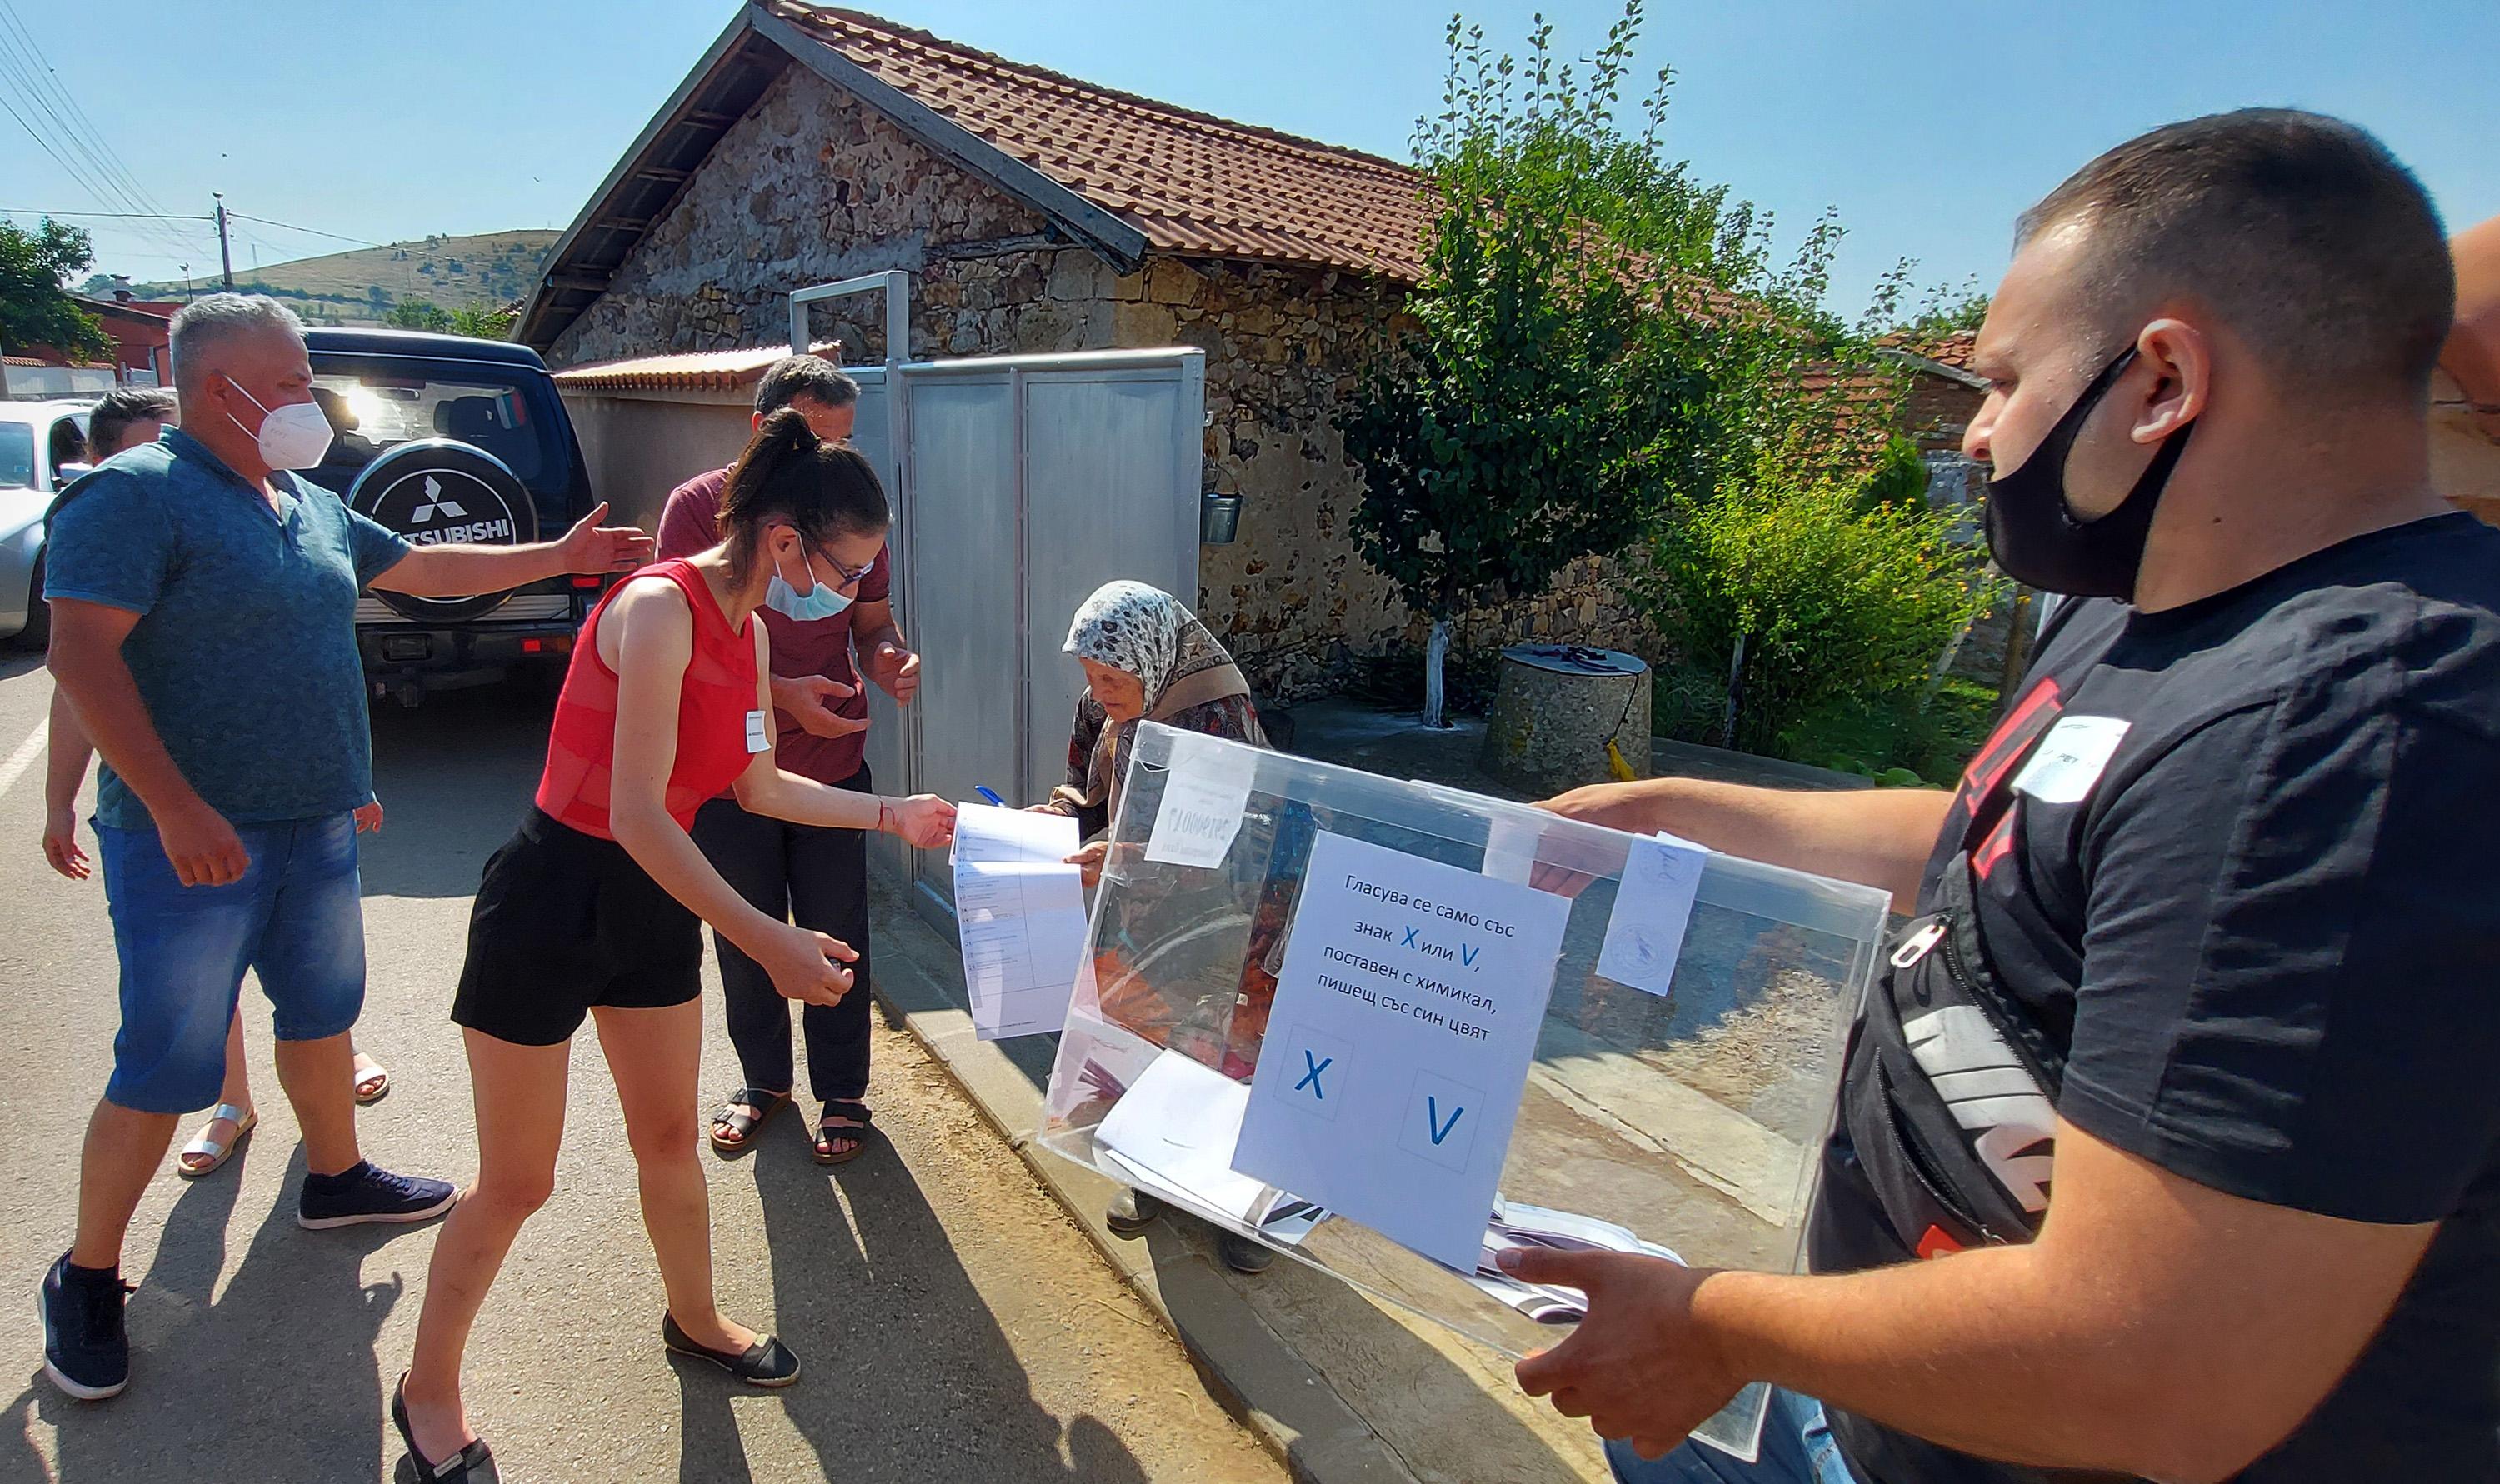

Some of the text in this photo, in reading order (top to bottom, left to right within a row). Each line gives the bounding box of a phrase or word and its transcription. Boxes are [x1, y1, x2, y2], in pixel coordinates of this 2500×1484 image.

[404, 519, 510, 546] TSUBISHI
[1344, 874, 1515, 937] Гласува се само със
[1353, 921, 1480, 972] знак X или V,
[1318, 974, 1490, 1042] пишещ със син цвят
[1323, 947, 1497, 1015] поставен с химикал,
[1294, 1049, 1464, 1145] X V
